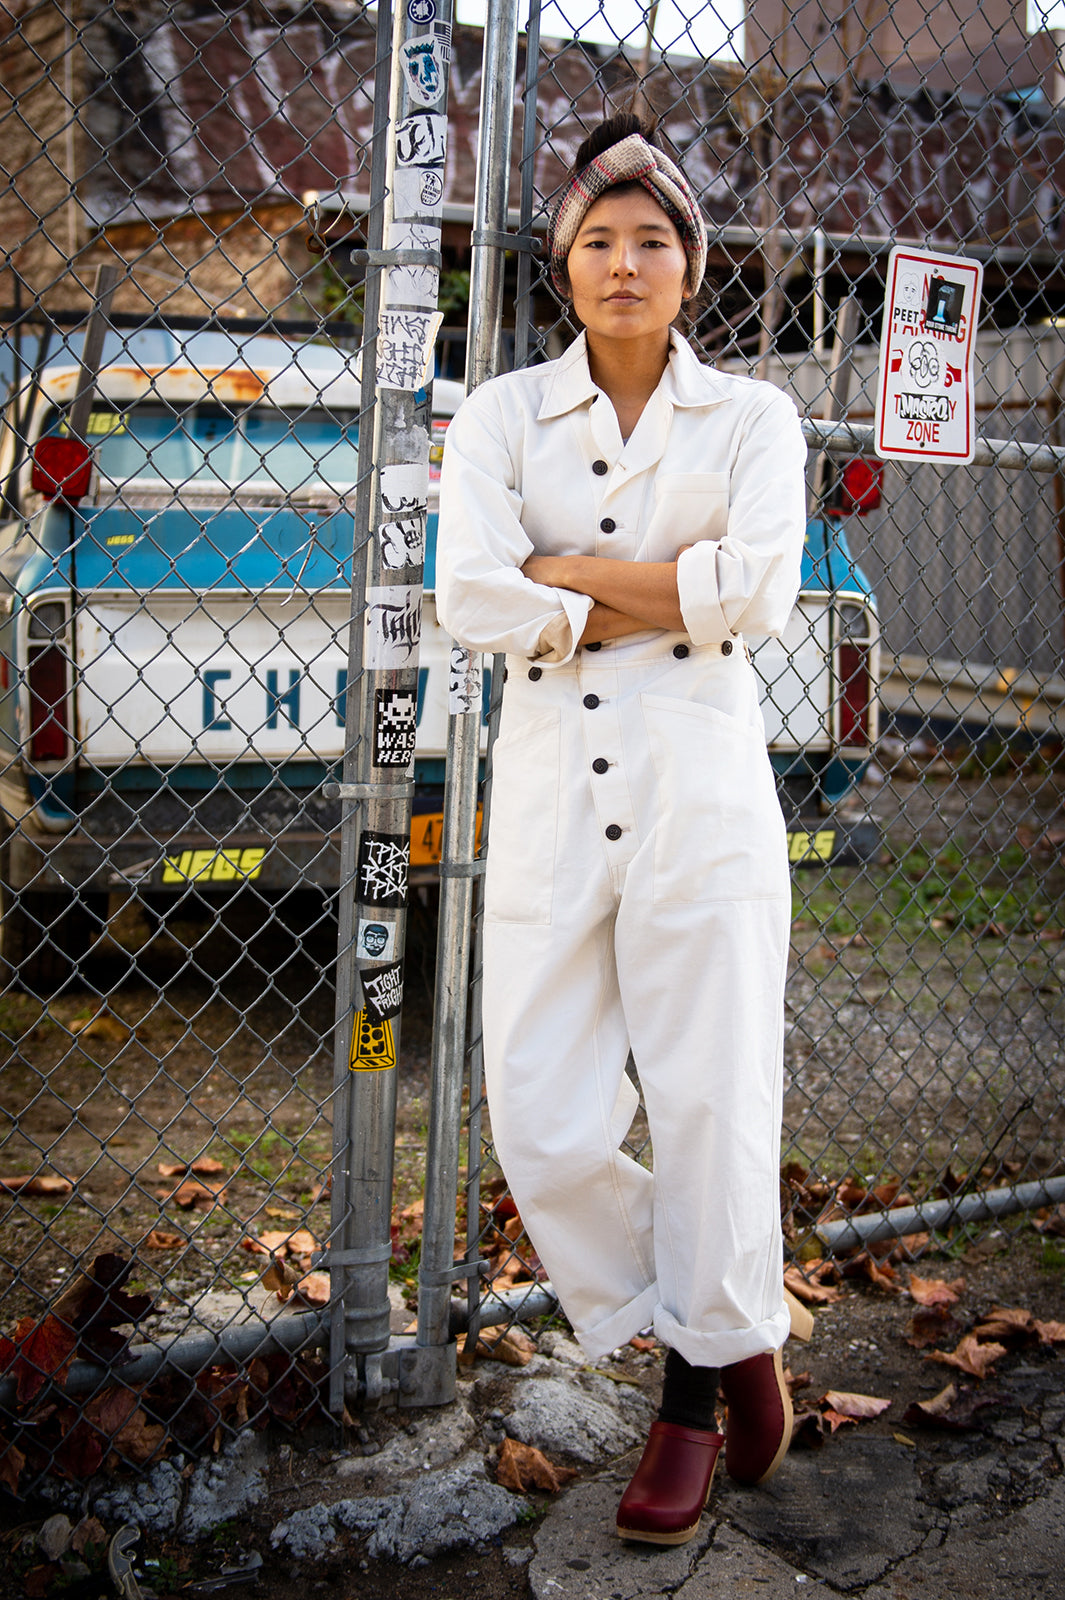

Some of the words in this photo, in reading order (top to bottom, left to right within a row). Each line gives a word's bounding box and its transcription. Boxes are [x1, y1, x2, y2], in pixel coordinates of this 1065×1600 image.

[893, 307, 919, 323] PEET
[906, 421, 940, 443] ZONE
[378, 732, 415, 749] WAS
[377, 750, 411, 763] HER
[163, 848, 266, 883] JEGS
[364, 965, 401, 997] TIGHT
